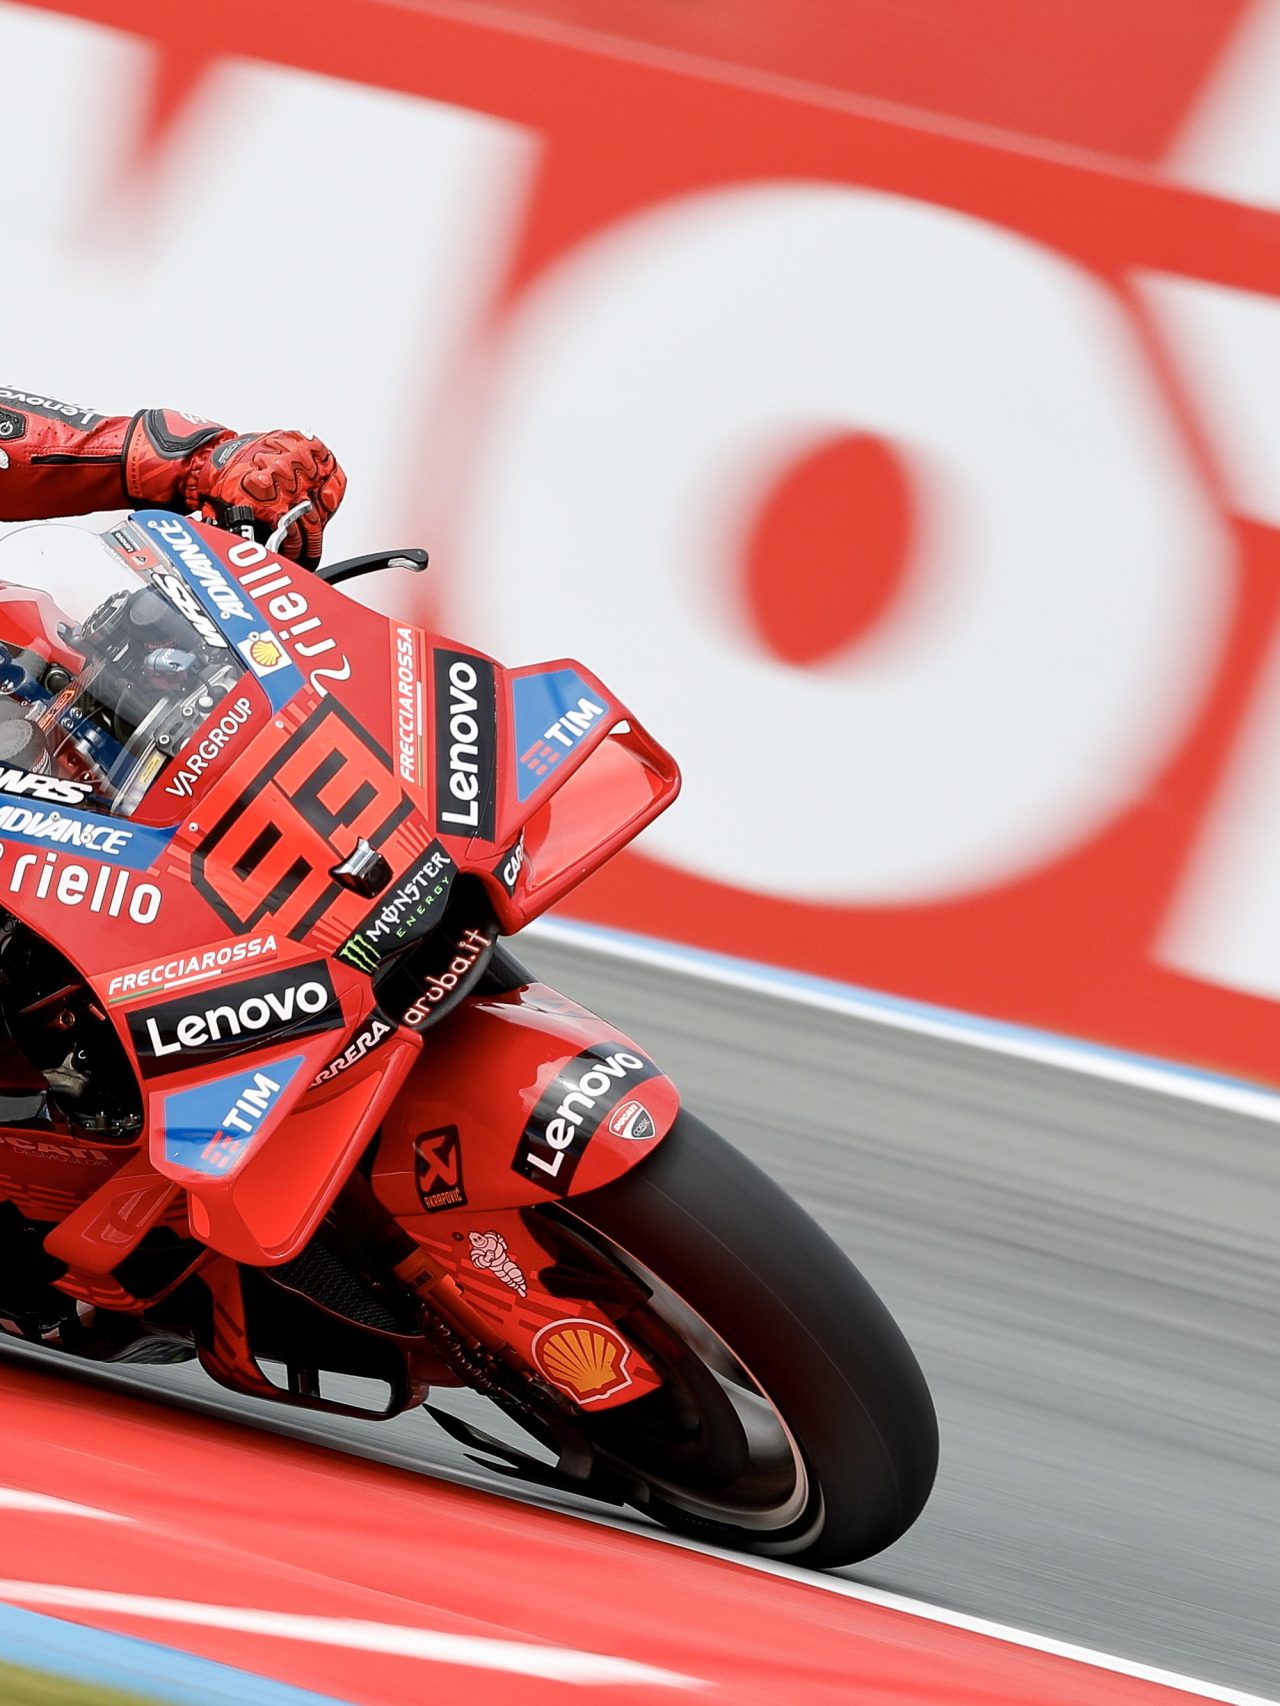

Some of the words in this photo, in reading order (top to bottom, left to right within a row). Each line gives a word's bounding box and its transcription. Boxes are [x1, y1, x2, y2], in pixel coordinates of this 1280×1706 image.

[151, 572, 229, 649] WRS
[160, 519, 255, 622] ADVANCE
[396, 626, 416, 784] FRECCIAROSSA
[441, 661, 479, 827] Lenovo
[543, 697, 604, 748] TIM
[165, 697, 254, 798] VARGROUP
[365, 851, 451, 943] MONSTER
[395, 875, 451, 939] ENERGY
[107, 935, 278, 996] FRECCIAROSSA
[403, 928, 491, 1025] aruba.it
[145, 980, 328, 1057] Lenovo
[222, 1071, 281, 1133] TIM
[526, 1051, 644, 1178] Lenovo
[612, 1102, 639, 1133] DUCATI
